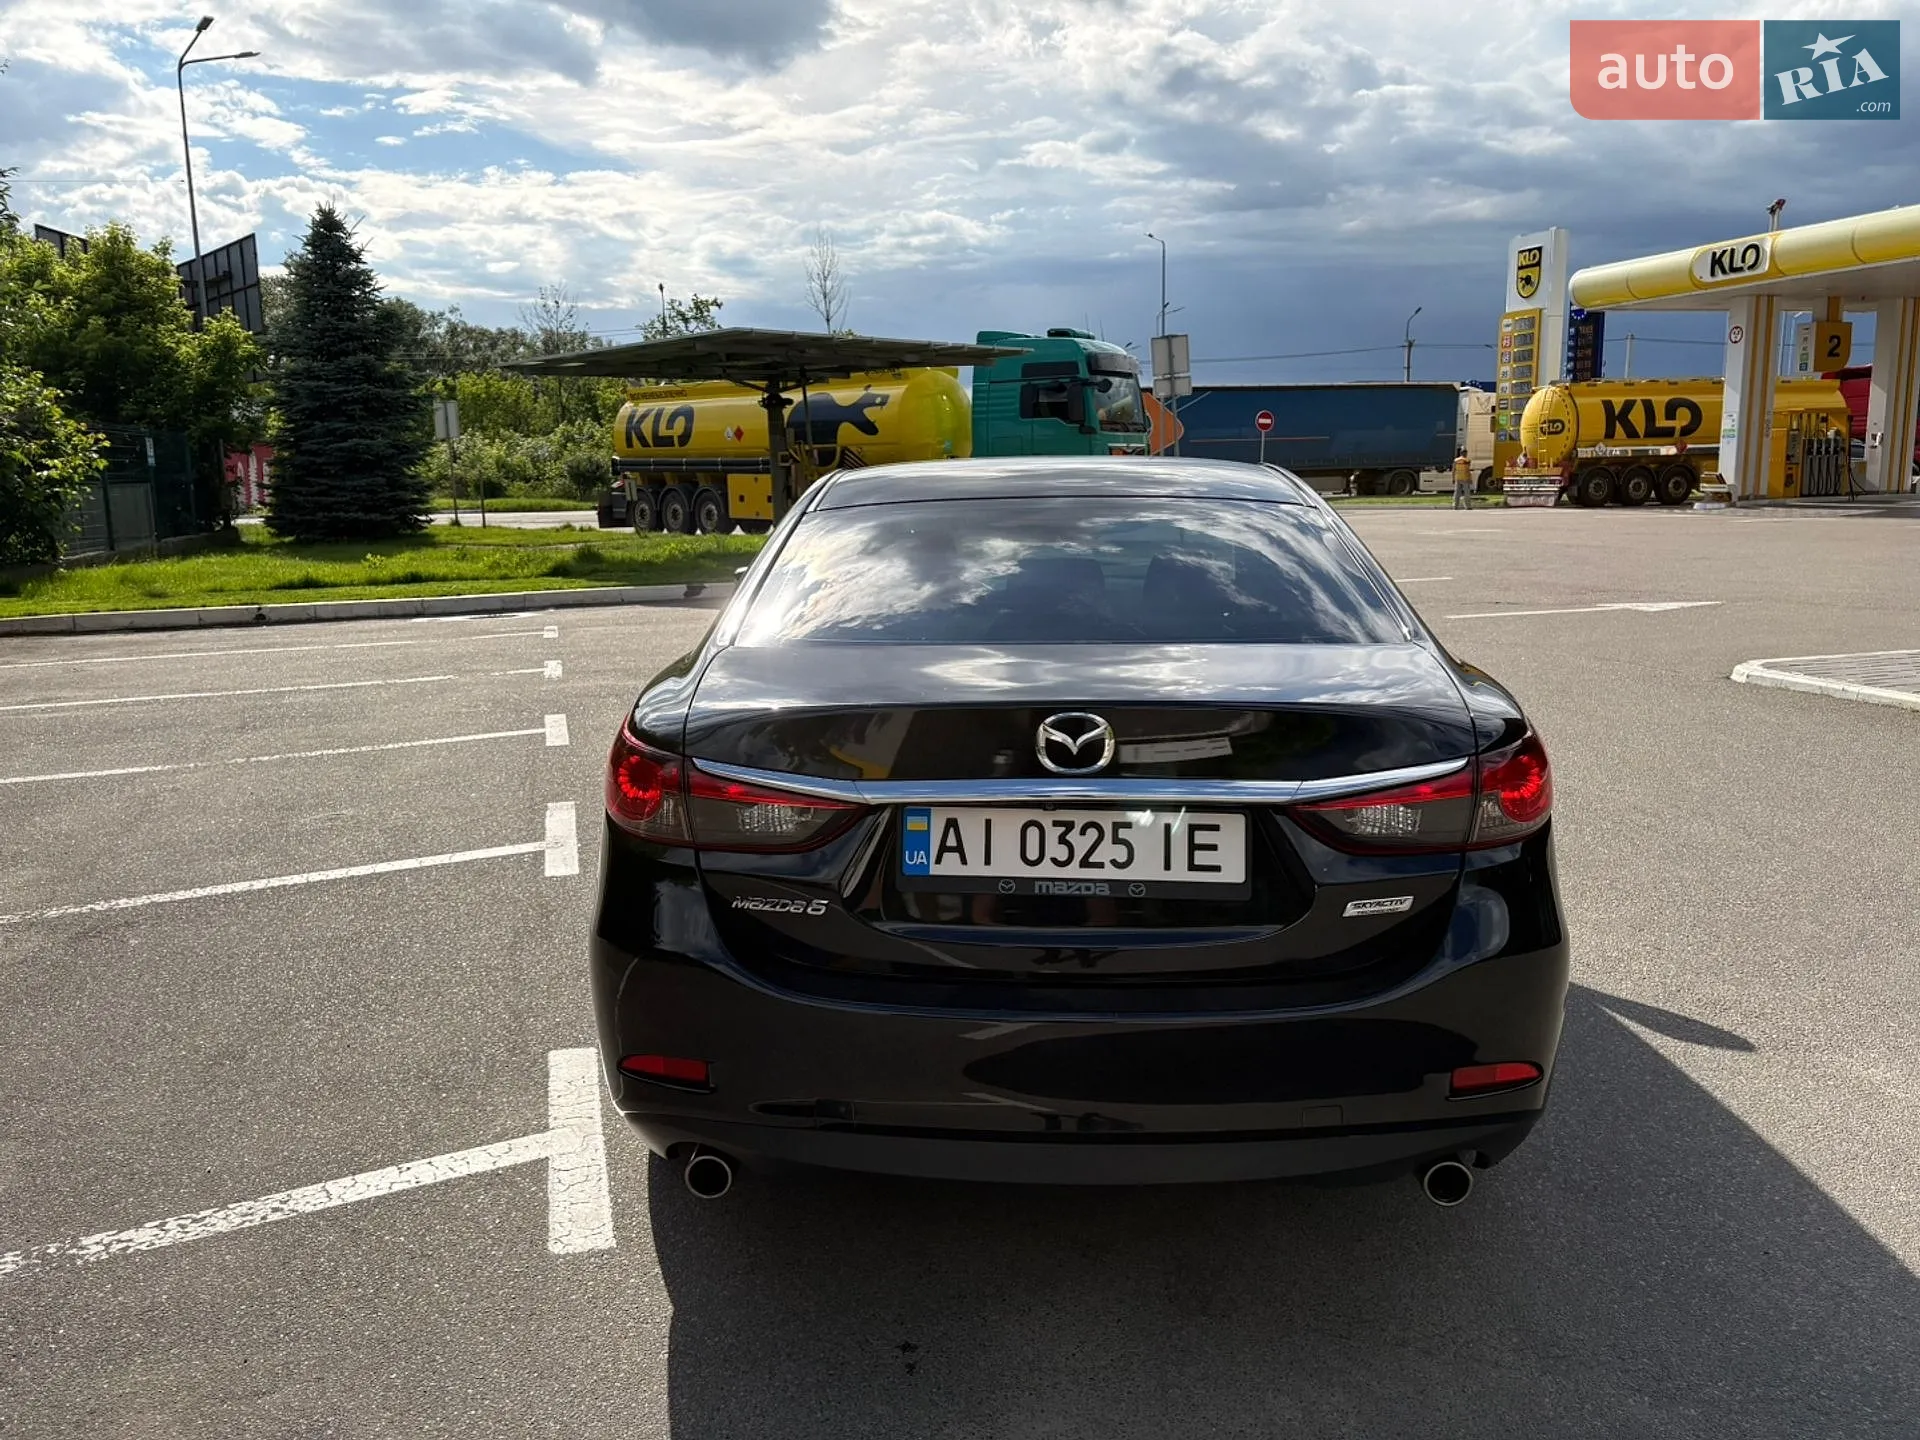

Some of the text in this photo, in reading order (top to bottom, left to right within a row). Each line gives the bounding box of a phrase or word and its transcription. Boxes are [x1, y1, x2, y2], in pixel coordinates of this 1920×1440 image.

[1518, 249, 1540, 267] KLO
[1711, 243, 1760, 277] KLO
[1827, 335, 1841, 357] 2
[626, 405, 695, 449] KLO
[1542, 420, 1563, 433] KLO
[1602, 397, 1703, 439] KLO
[934, 817, 1222, 873] AI 0325 IE
[905, 850, 928, 866] UA
[1351, 898, 1408, 910] SKYACTIV
